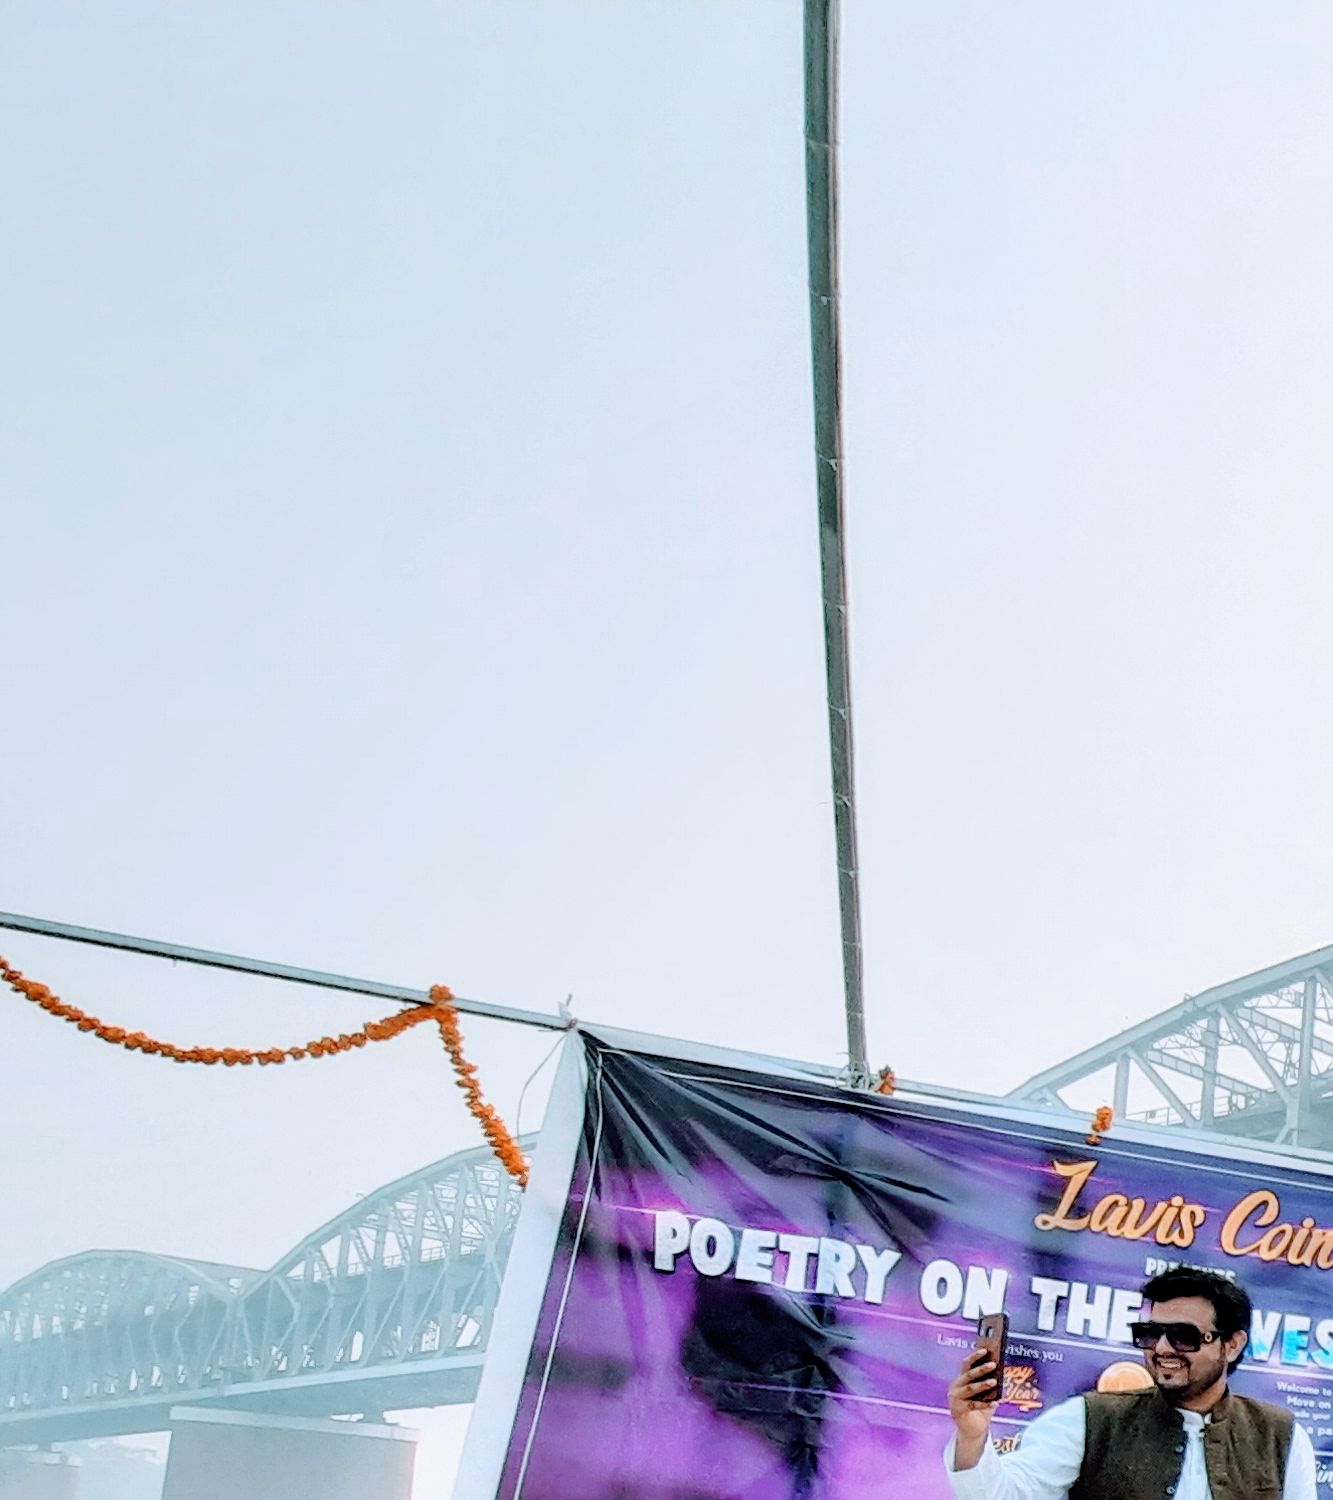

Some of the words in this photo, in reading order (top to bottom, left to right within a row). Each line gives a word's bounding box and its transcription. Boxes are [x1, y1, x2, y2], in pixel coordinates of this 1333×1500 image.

[653, 1211, 900, 1304] POETRY
[920, 1259, 1008, 1320] ON
[1031, 1276, 1143, 1342] THE
[1041, 1350, 1064, 1363] you
